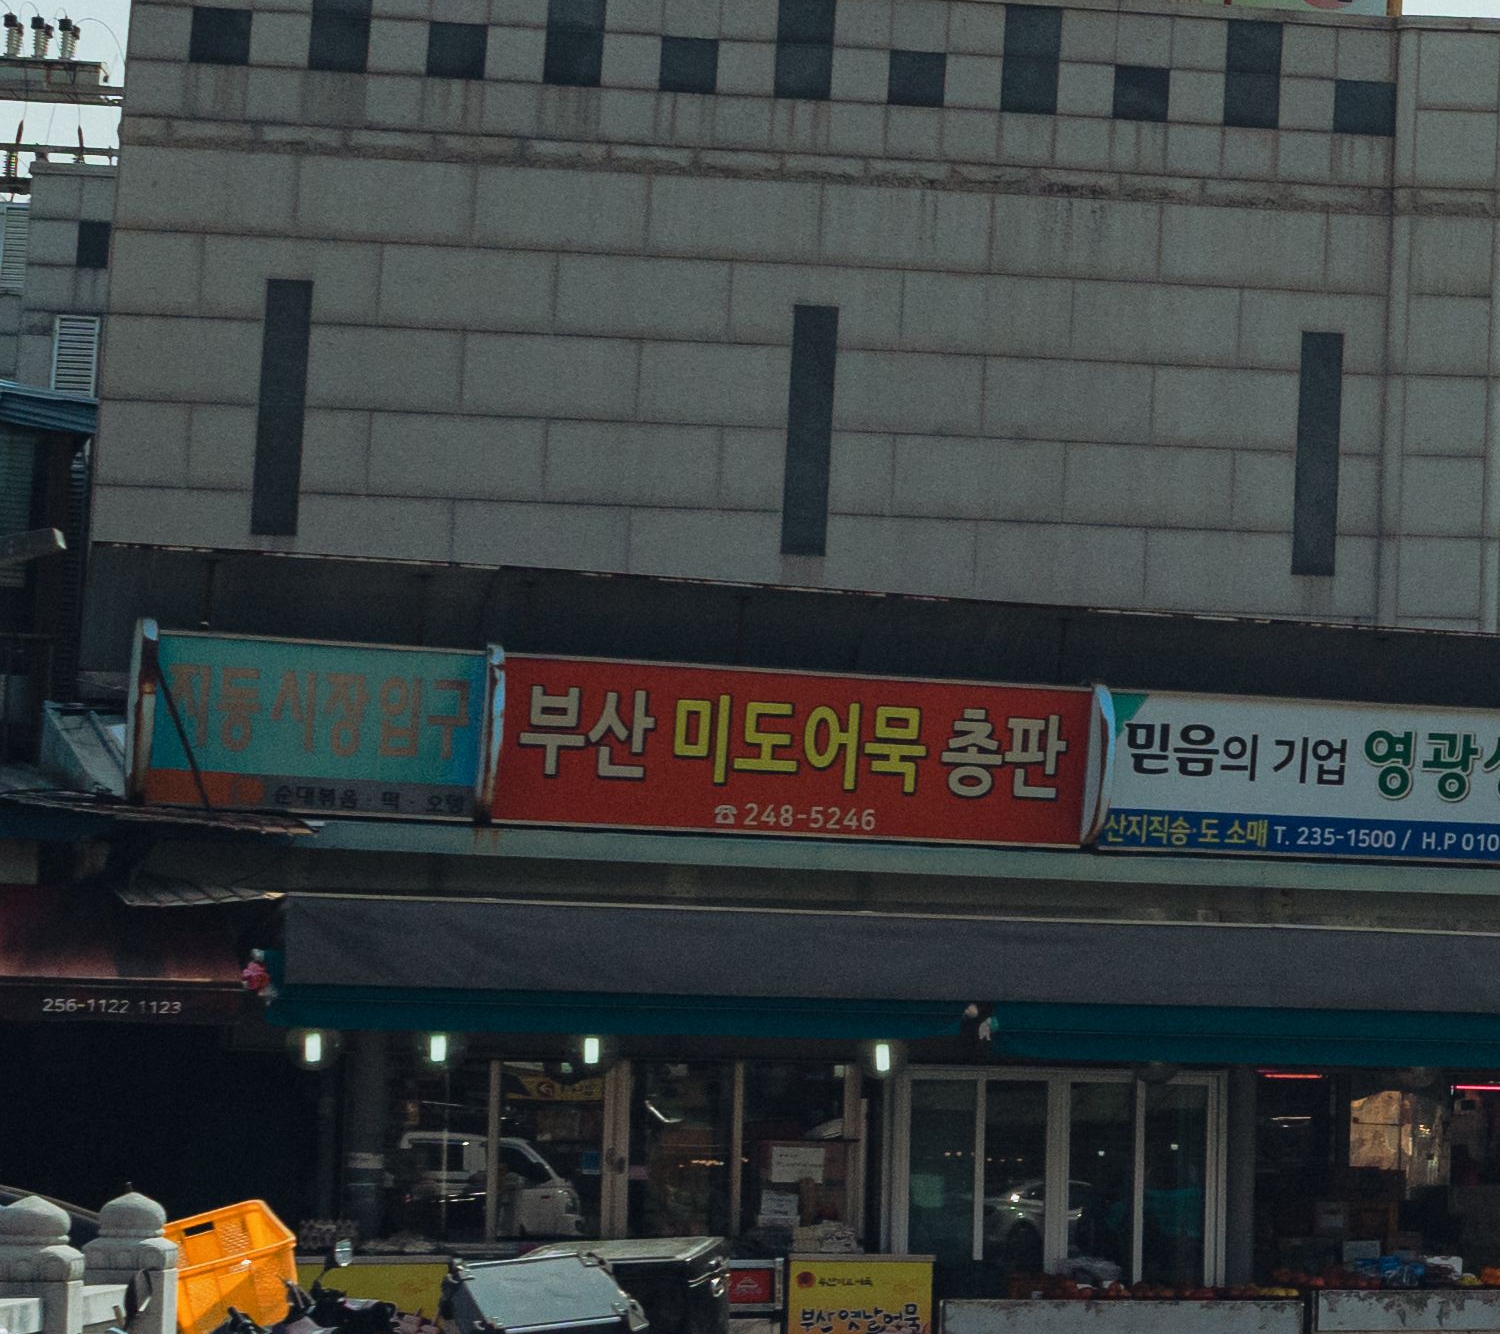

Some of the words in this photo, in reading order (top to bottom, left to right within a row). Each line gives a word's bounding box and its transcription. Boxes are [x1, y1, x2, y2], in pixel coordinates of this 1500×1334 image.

[517, 682, 657, 784] 부산
[671, 699, 930, 795] 미도어묵
[941, 709, 1070, 803] 총판
[1125, 720, 1259, 781] 믿음의
[1272, 736, 1349, 786] 기업
[743, 801, 877, 834] 248-5246
[1295, 826, 1398, 851] 235-1500
[42, 997, 131, 1016] 256-1122
[138, 998, 183, 1017] 1123
